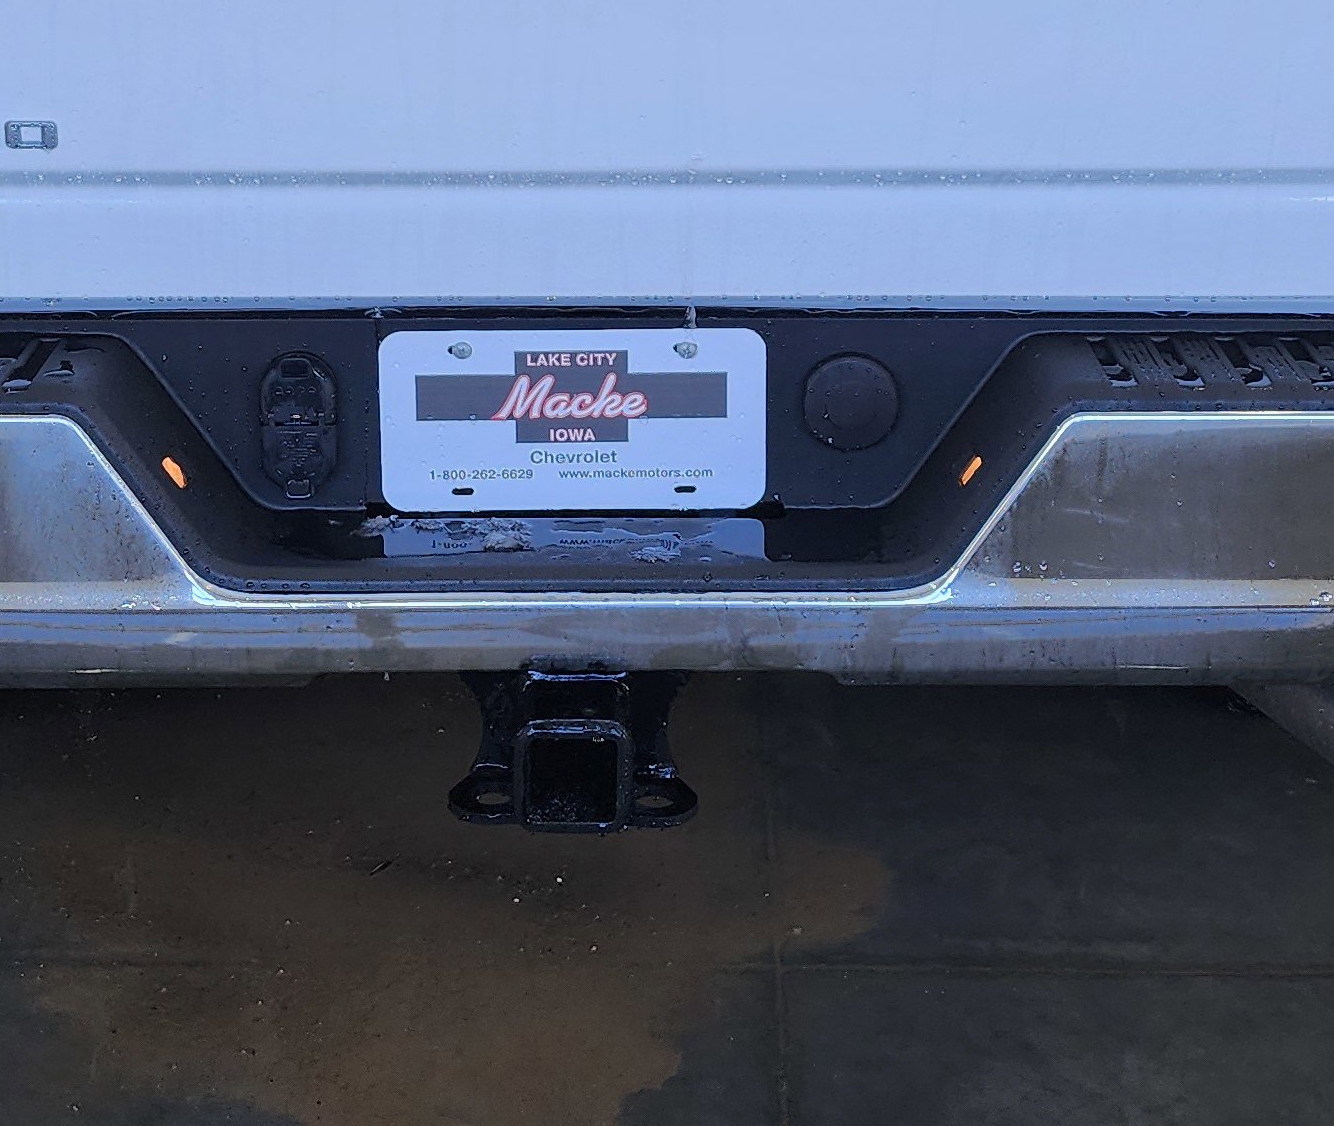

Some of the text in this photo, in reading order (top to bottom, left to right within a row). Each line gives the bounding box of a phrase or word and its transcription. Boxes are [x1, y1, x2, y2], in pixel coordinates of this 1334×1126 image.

[526, 353, 617, 366] LAKE CITY
[491, 372, 648, 420] Macke
[549, 428, 597, 442] IOWA
[530, 450, 618, 464] Chevrolet
[429, 468, 714, 480] 1-800-262-6629 www.mackemotors.com
